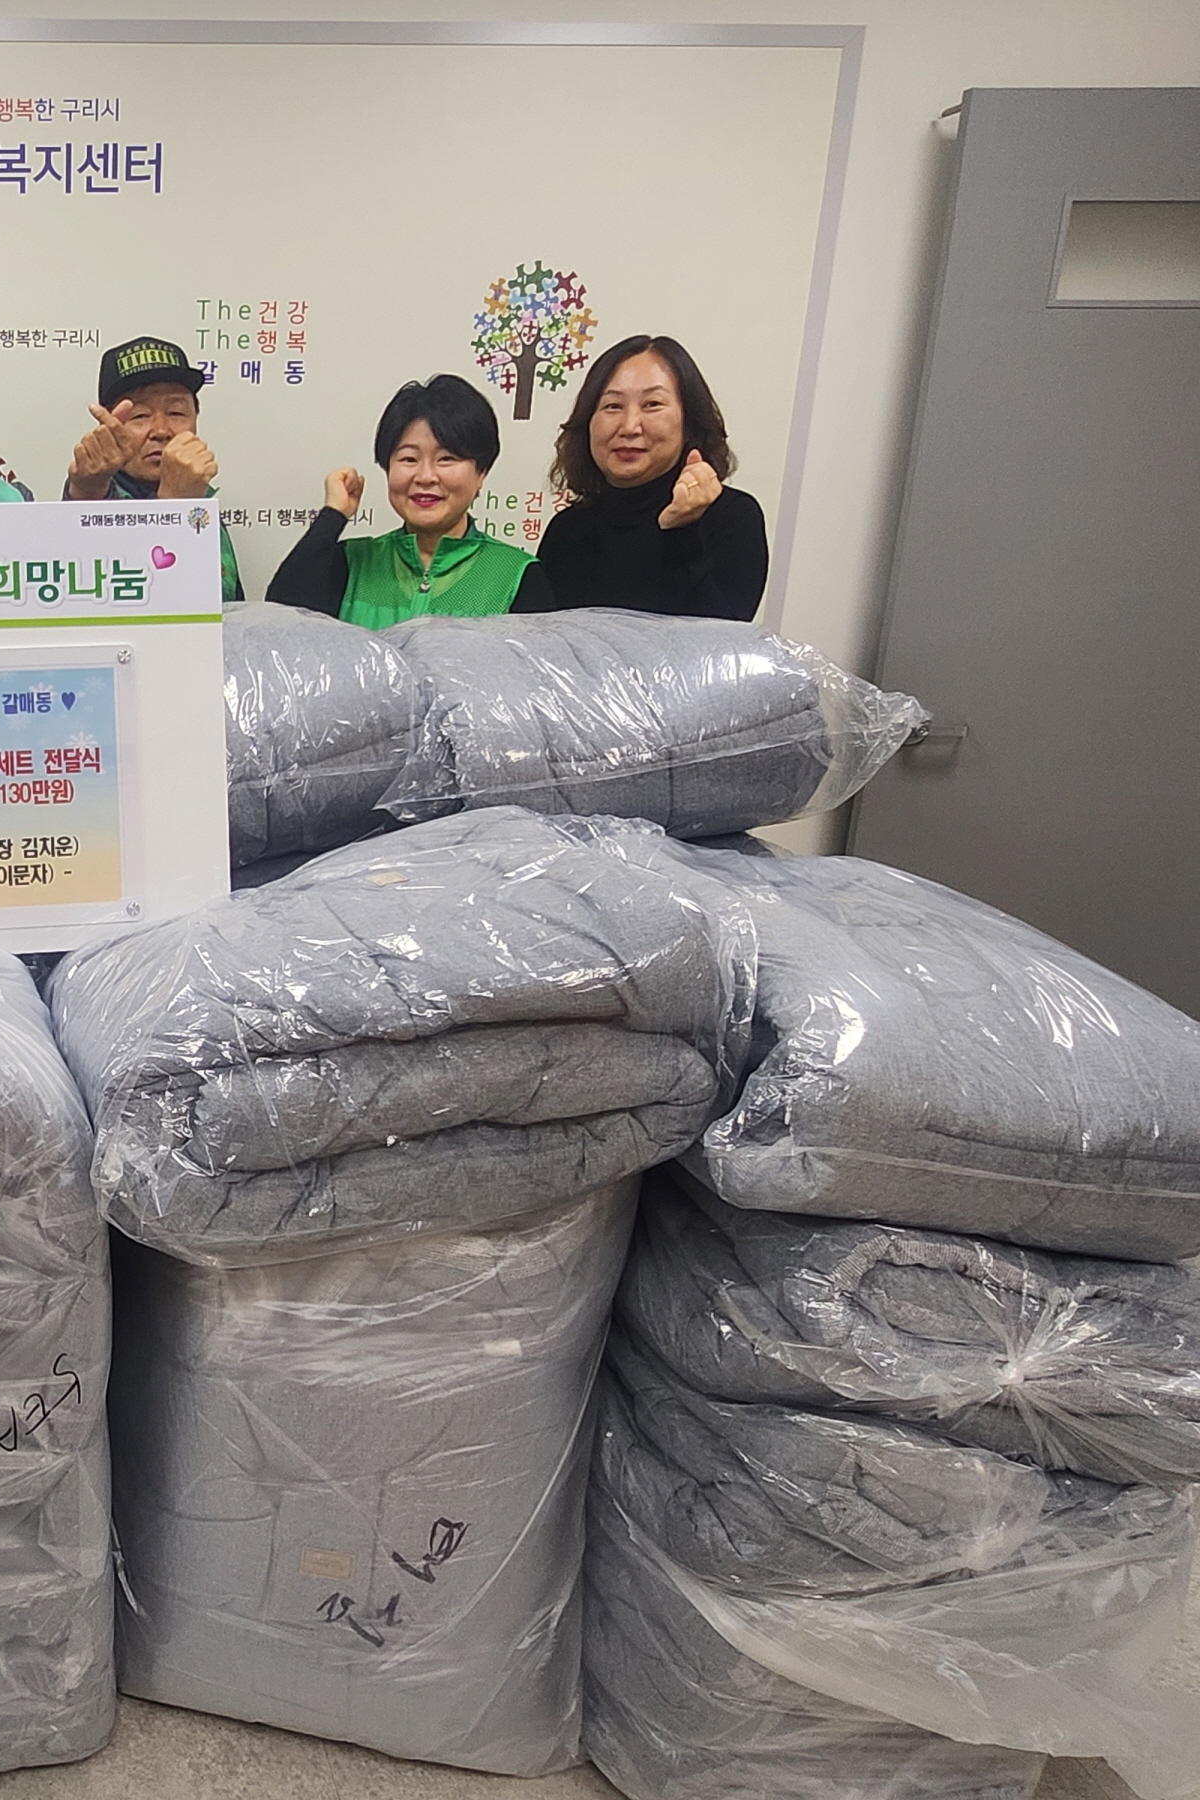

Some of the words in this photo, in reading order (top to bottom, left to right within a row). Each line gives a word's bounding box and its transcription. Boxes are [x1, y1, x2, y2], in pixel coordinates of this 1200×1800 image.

[60, 97, 120, 123] 구리시
[0, 329, 48, 349] 행복한
[52, 328, 100, 348] 구리시
[80, 512, 182, 527] 갈매동행정복지센터
[257, 508, 272, 527] 더
[2, 691, 52, 716] 갈매동
[43, 746, 101, 775] 전달식
